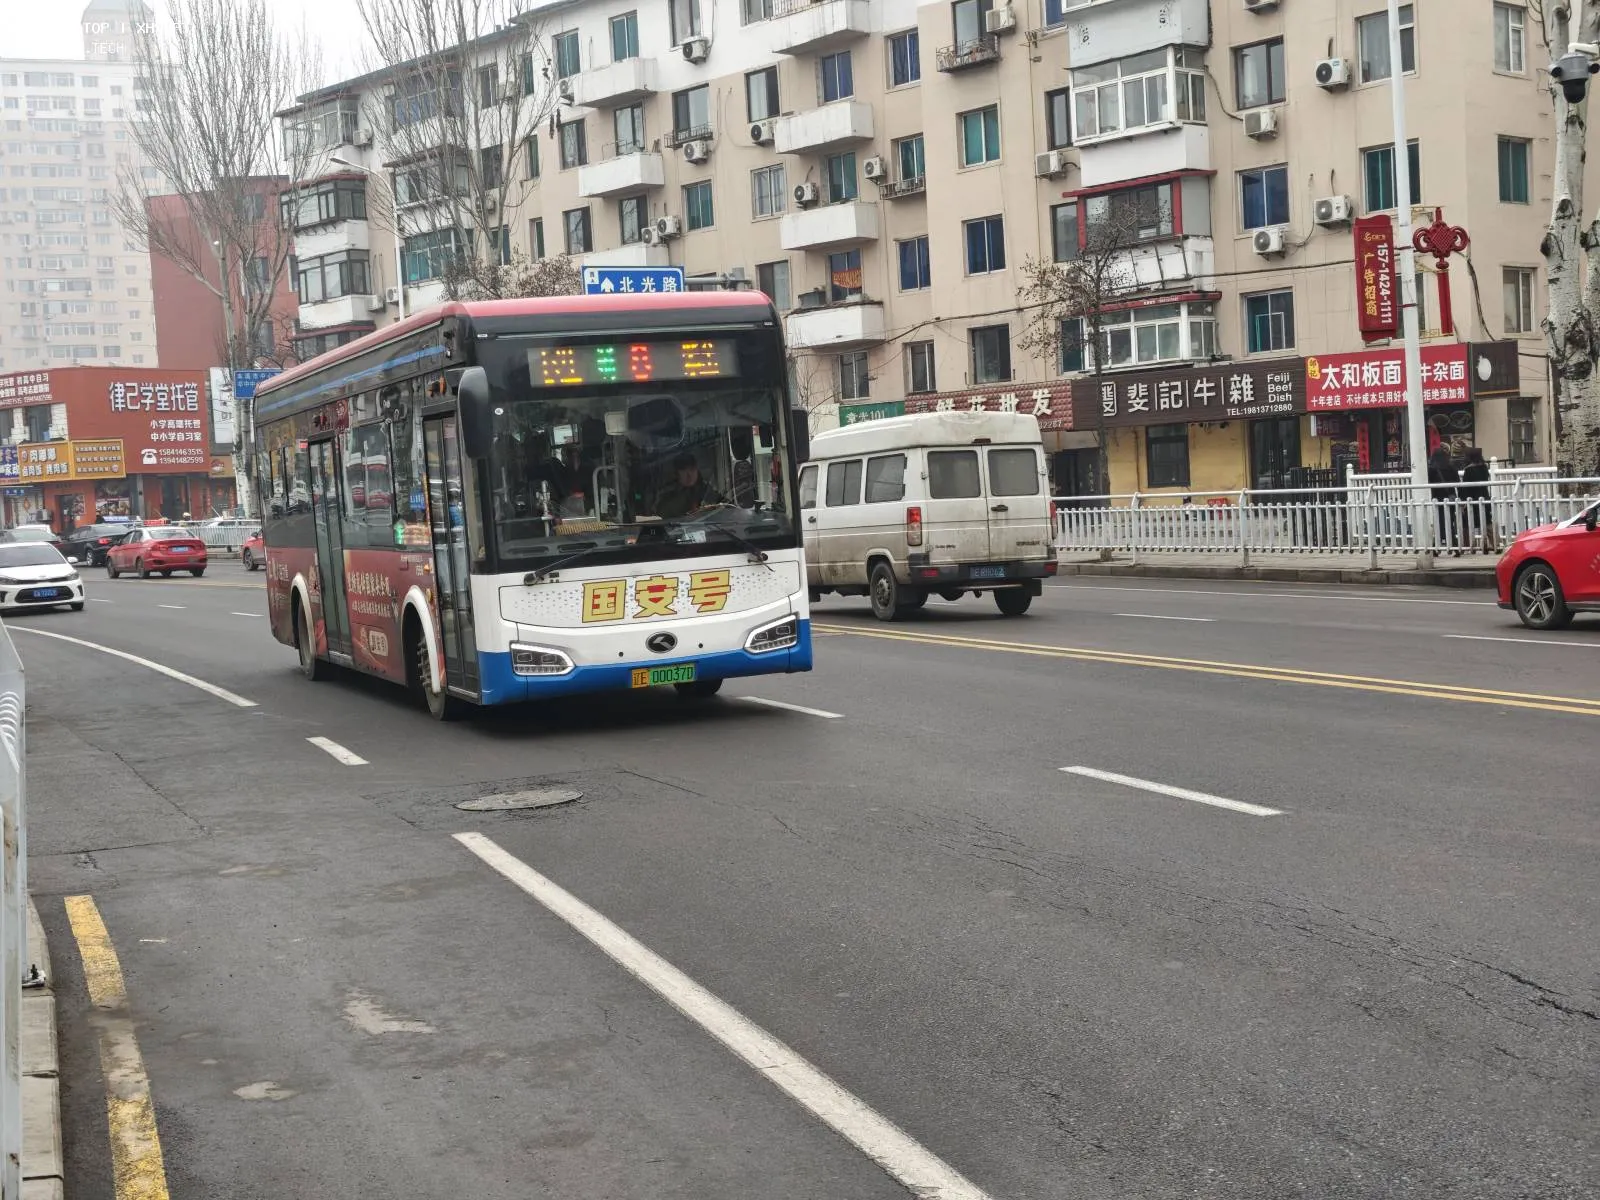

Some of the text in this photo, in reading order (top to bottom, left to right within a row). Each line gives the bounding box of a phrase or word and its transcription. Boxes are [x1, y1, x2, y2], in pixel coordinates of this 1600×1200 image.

[619, 276, 677, 293] 北光路
[1377, 243, 1393, 324] 157-1424-1111
[1267, 373, 1290, 385] Feiji
[1321, 359, 1465, 391] 太和板面 牛杂面
[108, 381, 200, 413] 律己学堂托管
[1268, 383, 1292, 393] Beef
[1268, 392, 1292, 403] Dish
[1311, 394, 1342, 408] 十年老店
[1423, 386, 1465, 401] 拒绝添加剂
[582, 569, 732, 624] 国安号
